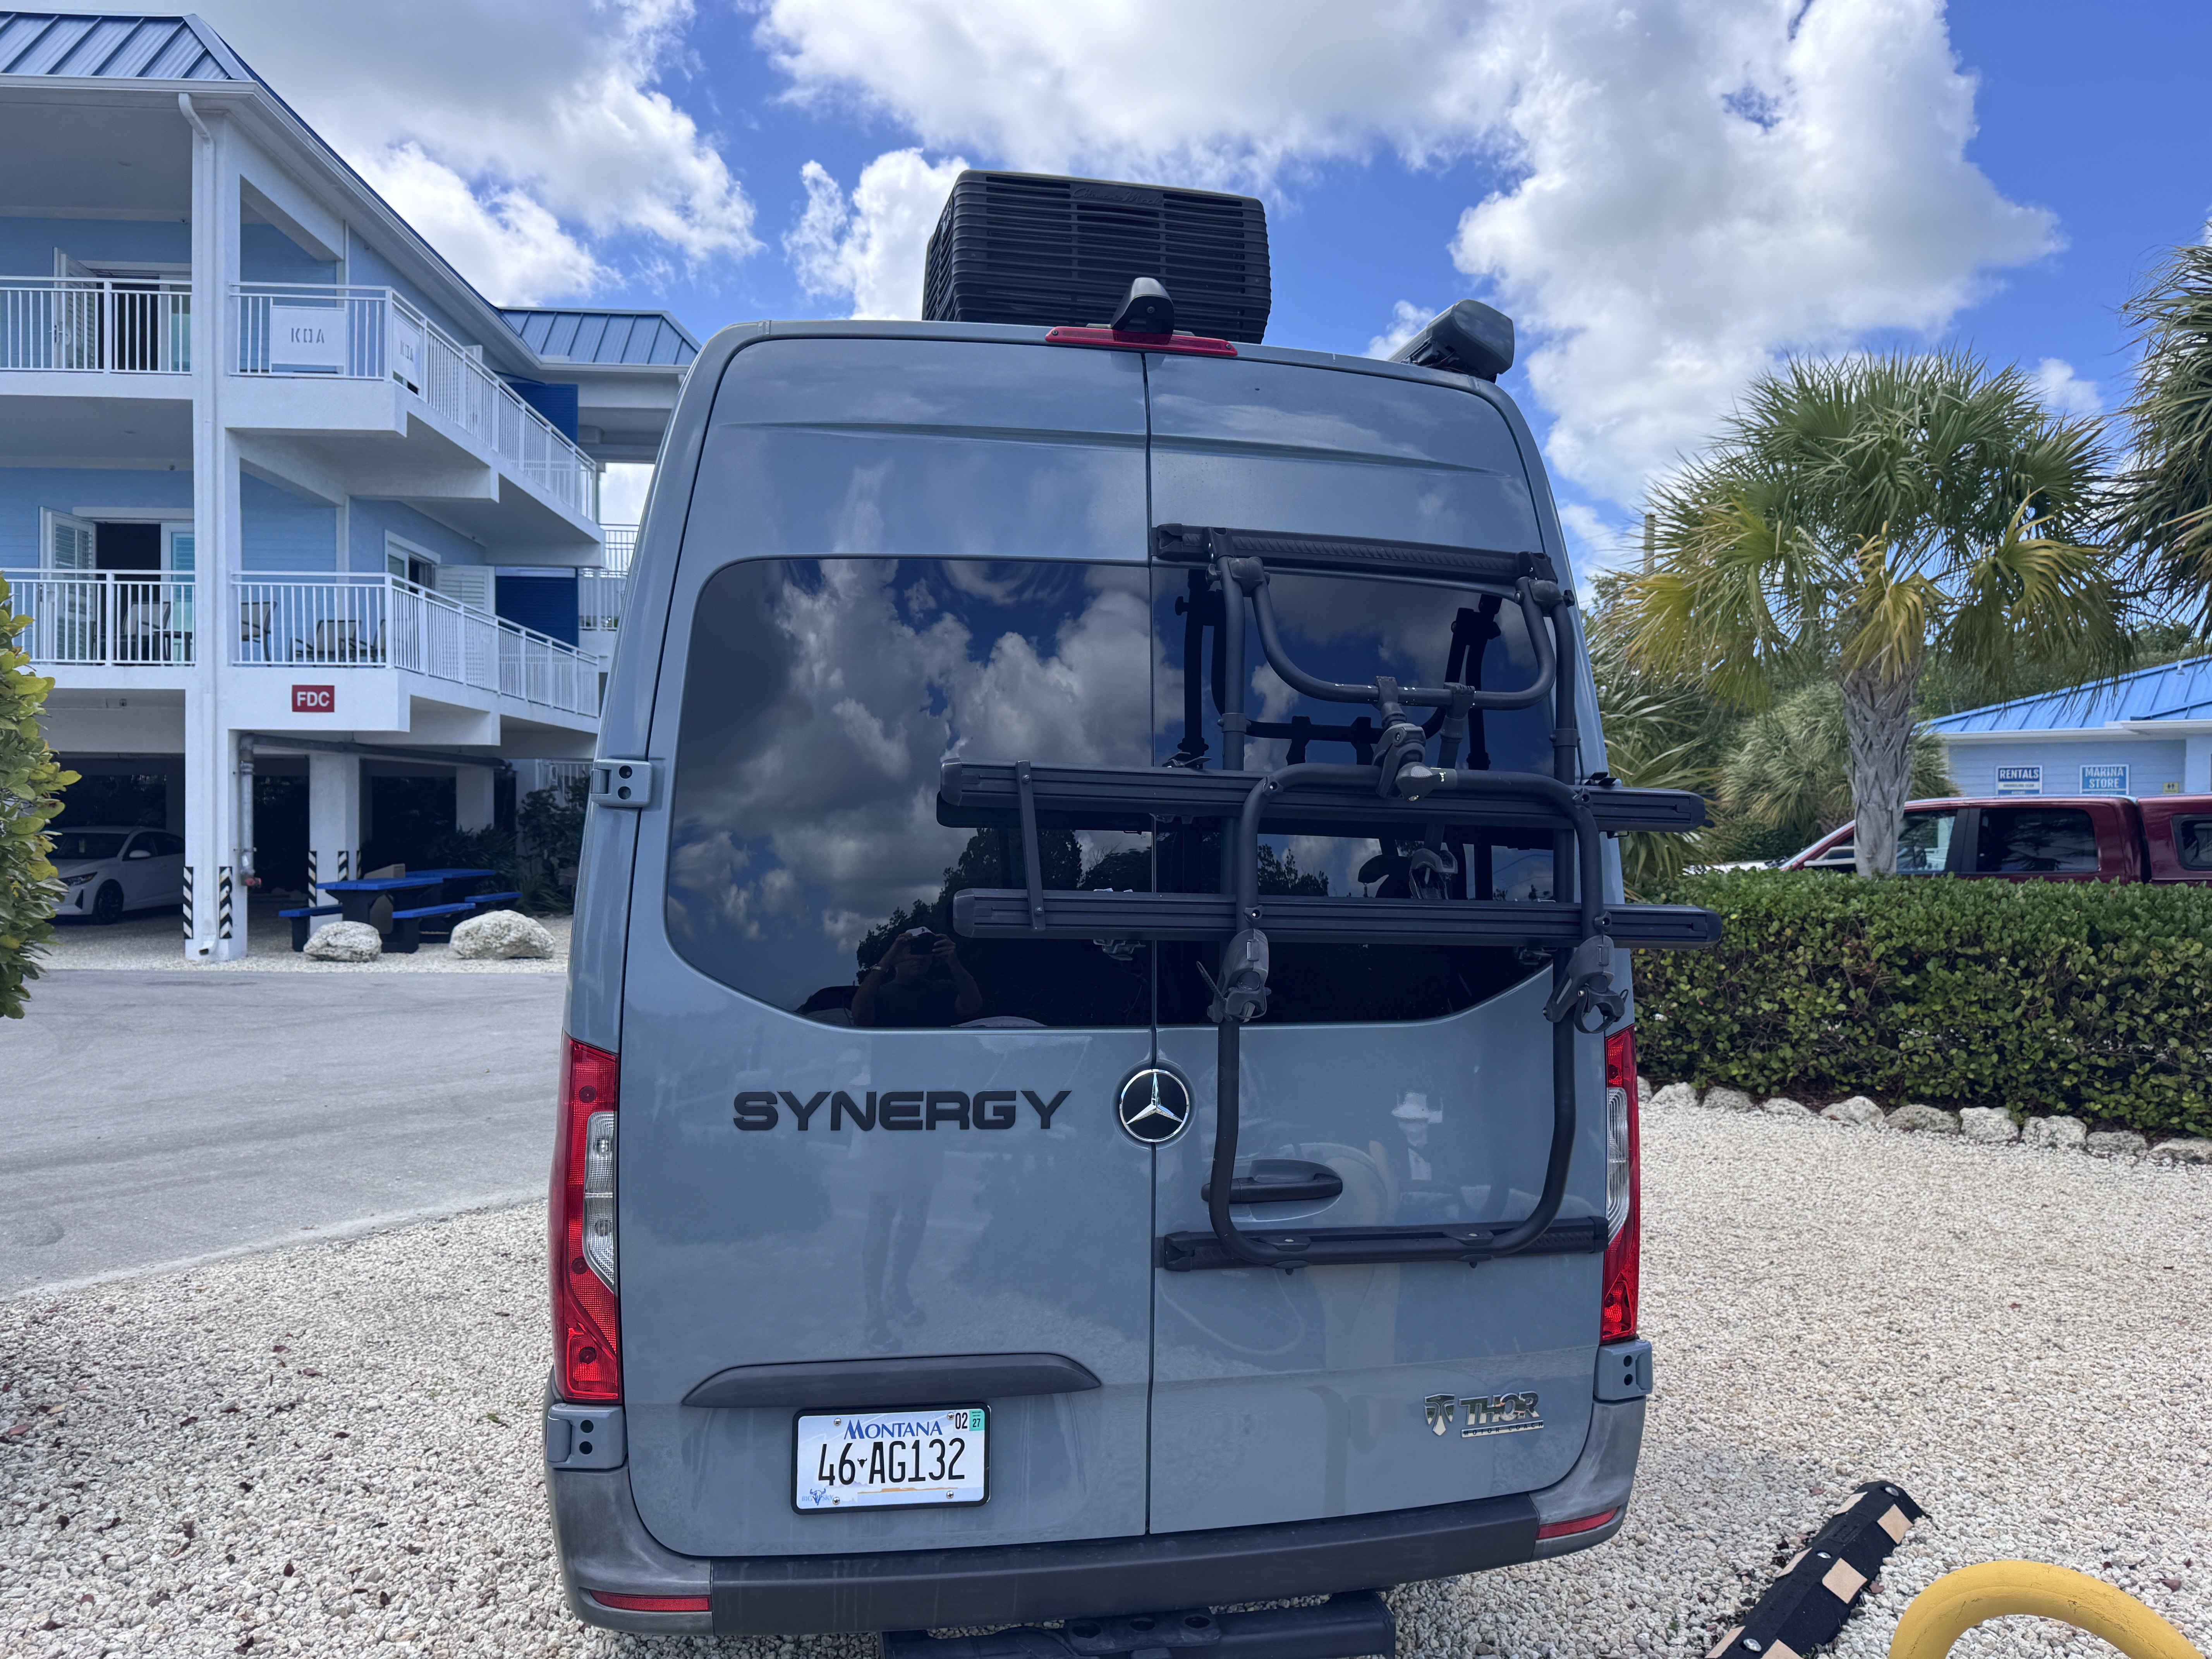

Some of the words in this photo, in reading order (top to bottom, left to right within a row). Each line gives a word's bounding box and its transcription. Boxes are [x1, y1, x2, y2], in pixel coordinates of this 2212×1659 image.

[291, 328, 325, 343] KOA
[297, 691, 330, 707] FDC
[2000, 769, 2039, 779] RENTALS
[2085, 767, 2124, 777] MARINA
[2089, 778, 2119, 788] STORE
[733, 1090, 1072, 1131] SYNERGY
[1458, 1391, 1540, 1425] THOR
[955, 1412, 968, 1429] 02
[972, 1419, 981, 1427] 27
[1463, 1427, 1500, 1436] MOTOR
[1508, 1422, 1543, 1431] COACH
